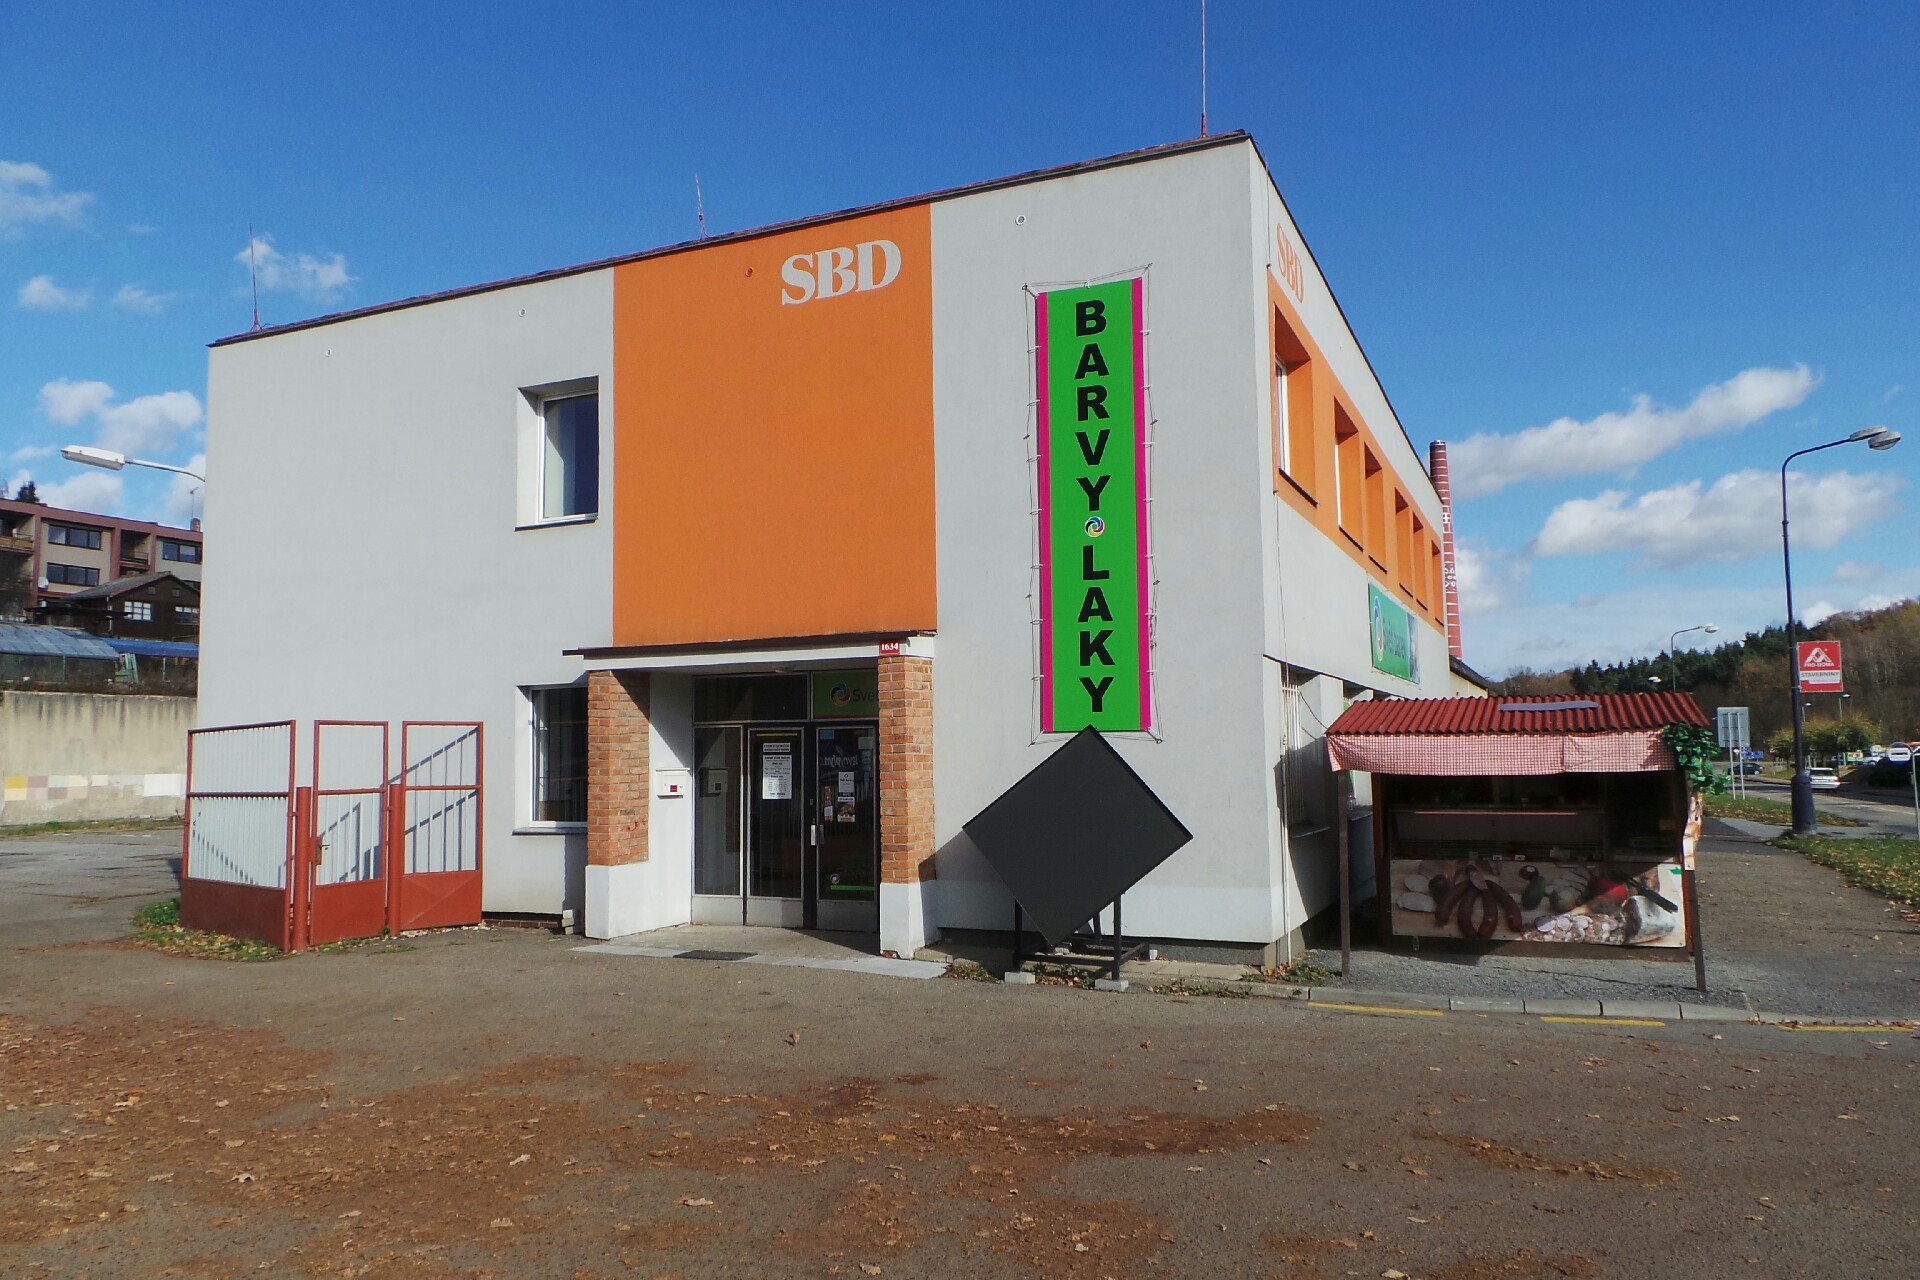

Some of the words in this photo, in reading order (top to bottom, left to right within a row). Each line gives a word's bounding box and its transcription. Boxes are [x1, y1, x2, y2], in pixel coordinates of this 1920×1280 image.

[781, 239, 902, 305] SBD
[1276, 223, 1304, 303] SBD
[1074, 299, 1112, 511] BARVY
[881, 642, 899, 651] 1634
[1077, 544, 1116, 713] LAKY
